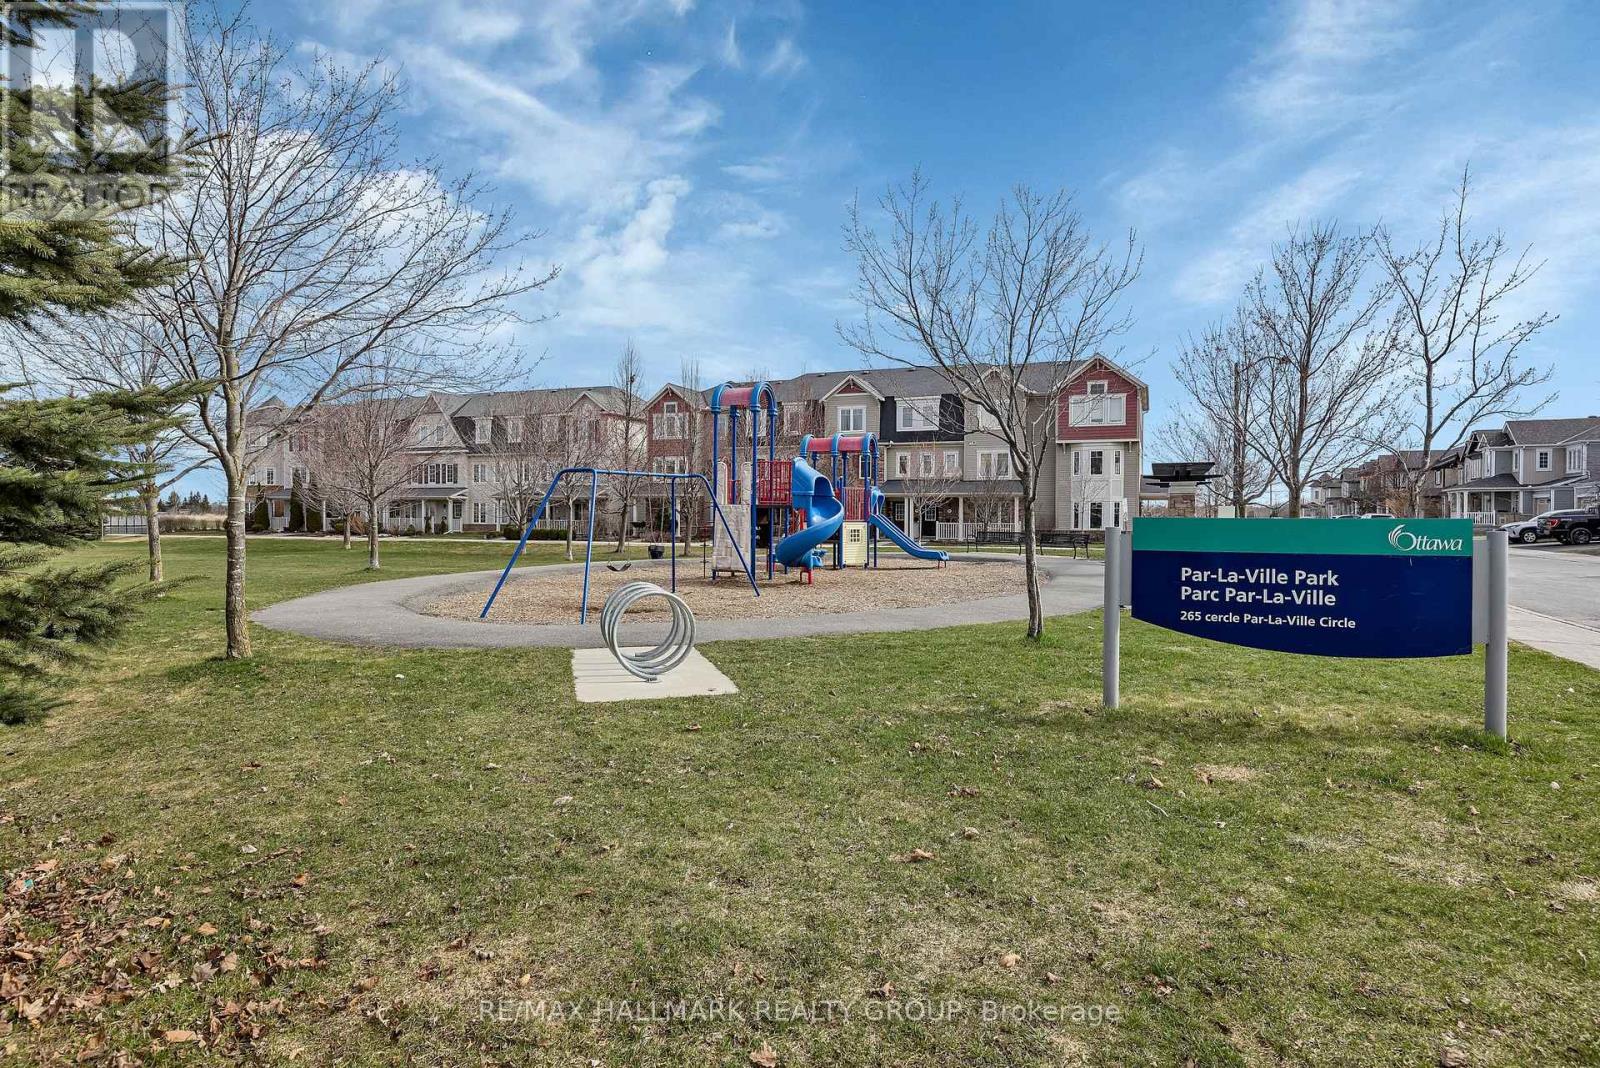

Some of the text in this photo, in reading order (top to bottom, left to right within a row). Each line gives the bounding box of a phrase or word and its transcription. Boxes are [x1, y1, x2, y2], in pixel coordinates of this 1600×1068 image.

[1389, 525, 1463, 551] Ottawa
[1180, 567, 1339, 586] Par-La-Ville Park
[1180, 586, 1336, 606] Parc Par-La-Ville
[1180, 610, 1356, 628] 265 cercle Par-La-Ville Circle
